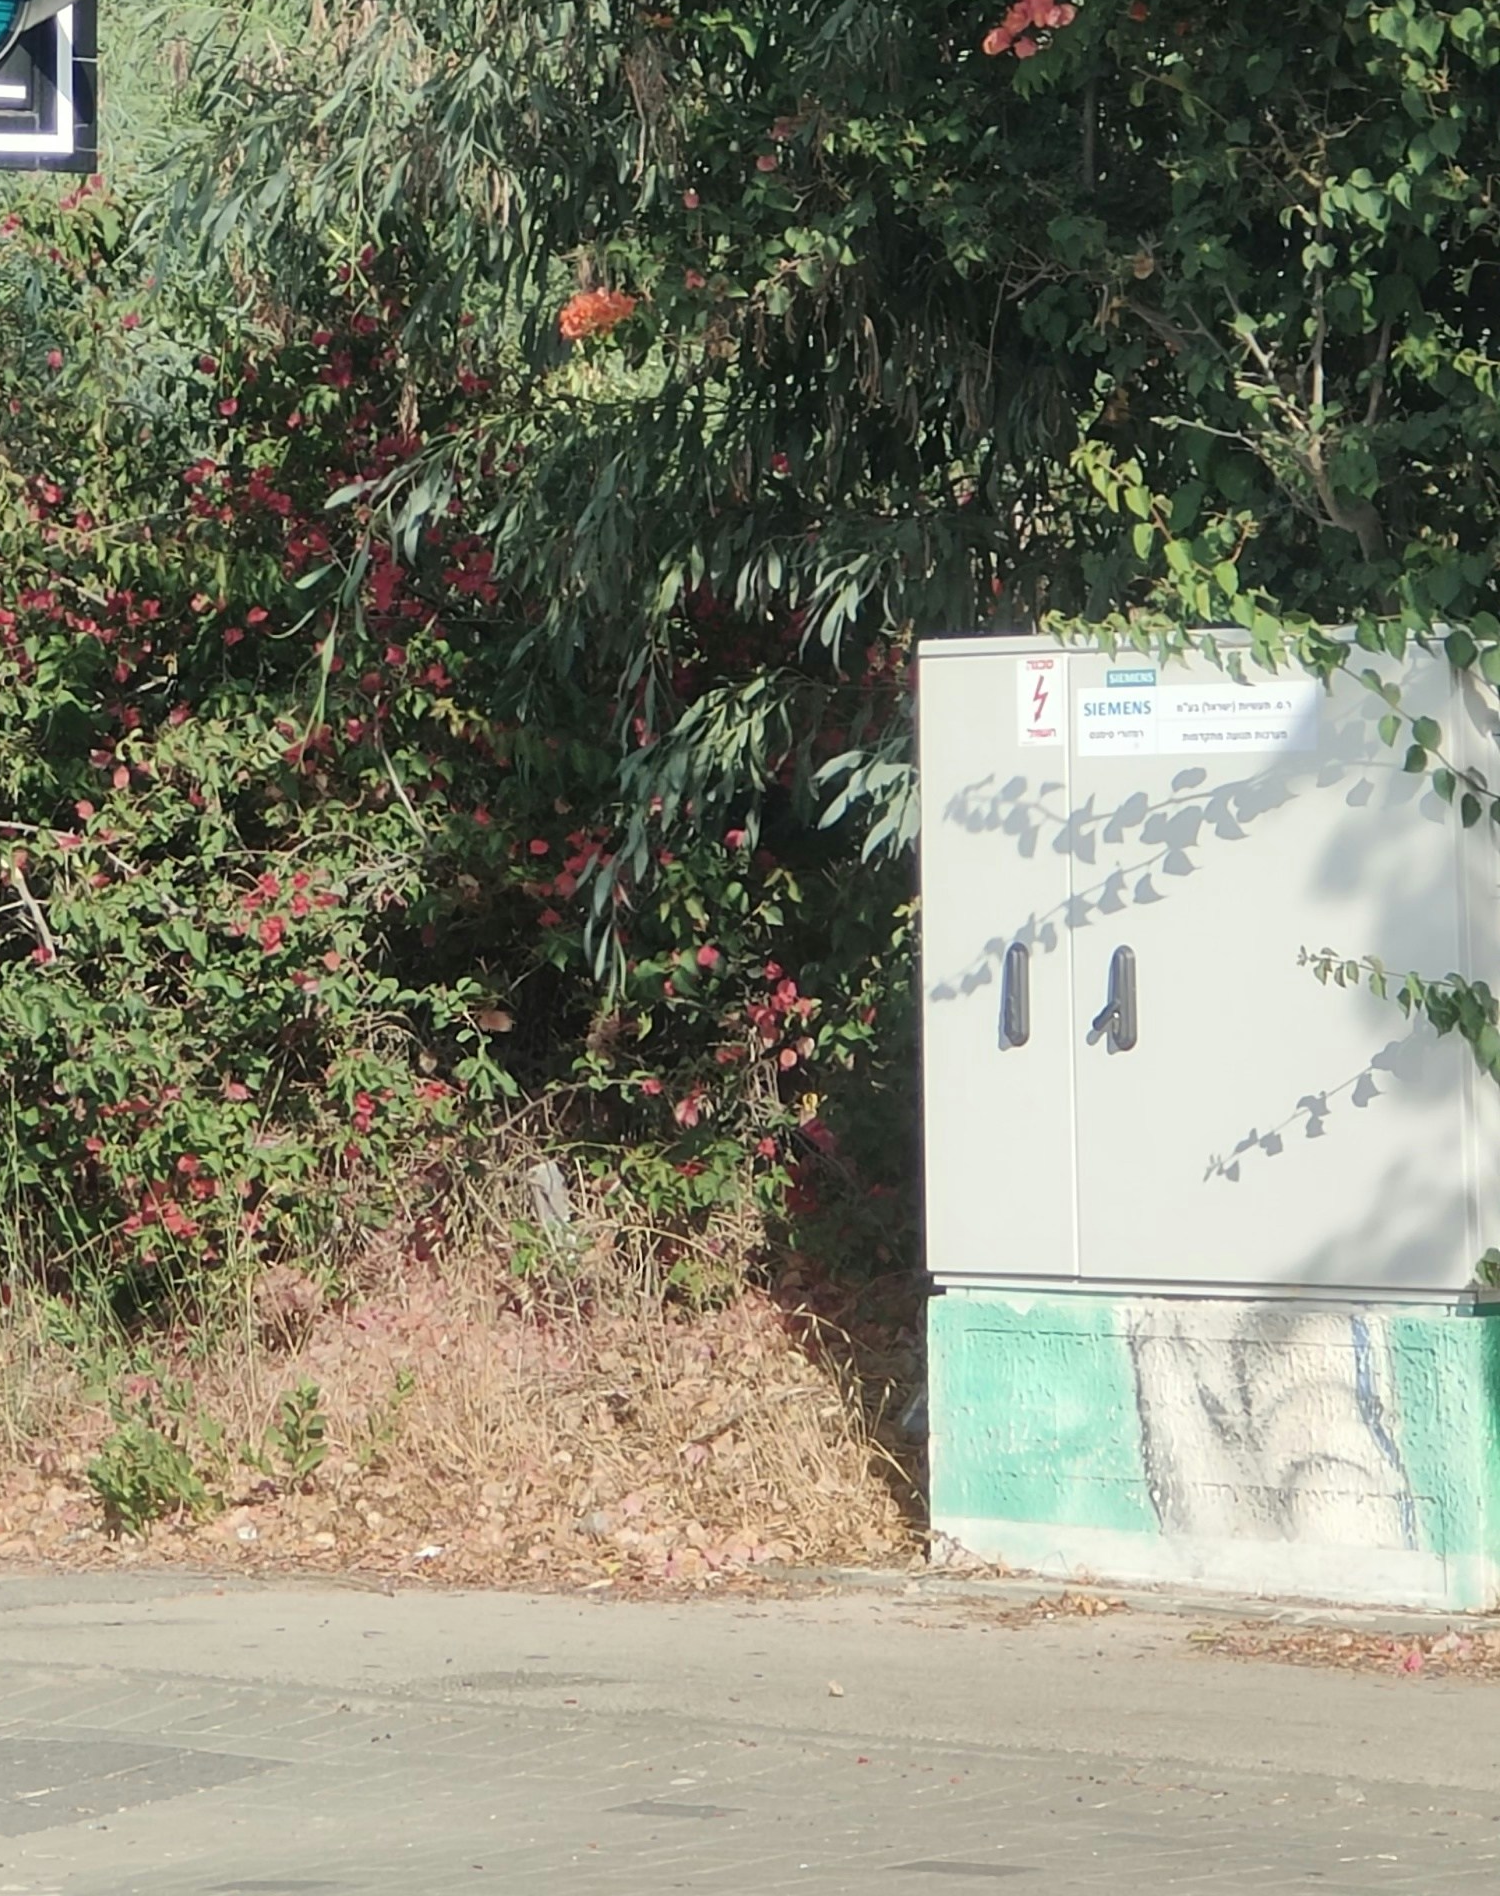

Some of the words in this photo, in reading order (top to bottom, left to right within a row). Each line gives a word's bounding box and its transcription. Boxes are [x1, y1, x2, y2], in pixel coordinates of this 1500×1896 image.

[1026, 659, 1054, 670] סכנה
[1109, 672, 1154, 684] SIEMENS
[1083, 700, 1152, 716] SIEMENS
[1026, 728, 1056, 738] חשמל
